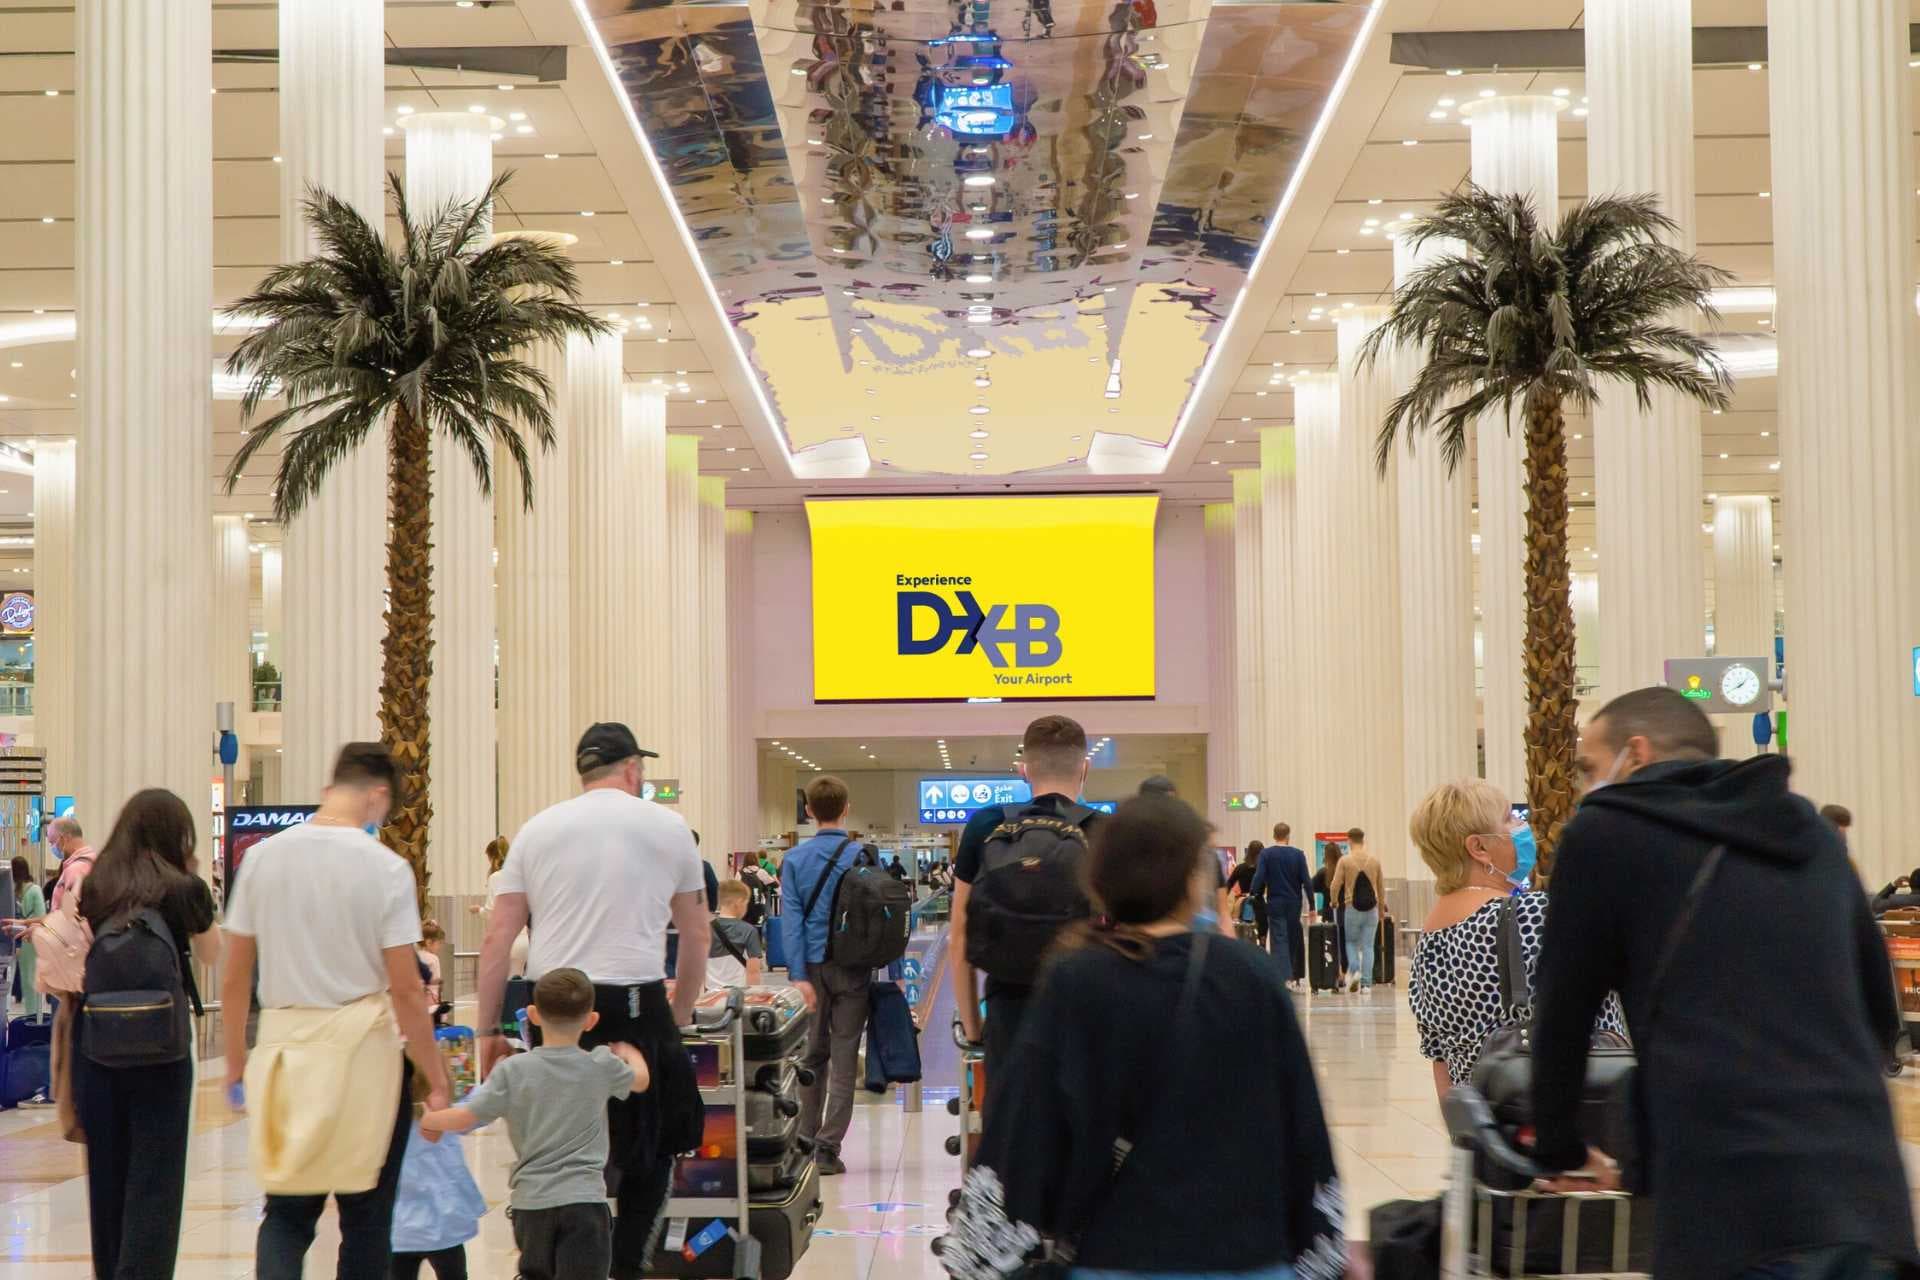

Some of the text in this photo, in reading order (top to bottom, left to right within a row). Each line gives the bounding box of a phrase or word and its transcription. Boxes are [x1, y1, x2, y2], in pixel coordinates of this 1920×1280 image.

[896, 573, 972, 588] Experience
[994, 673, 1073, 686] Your Airport
[994, 794, 1014, 803] Exit
